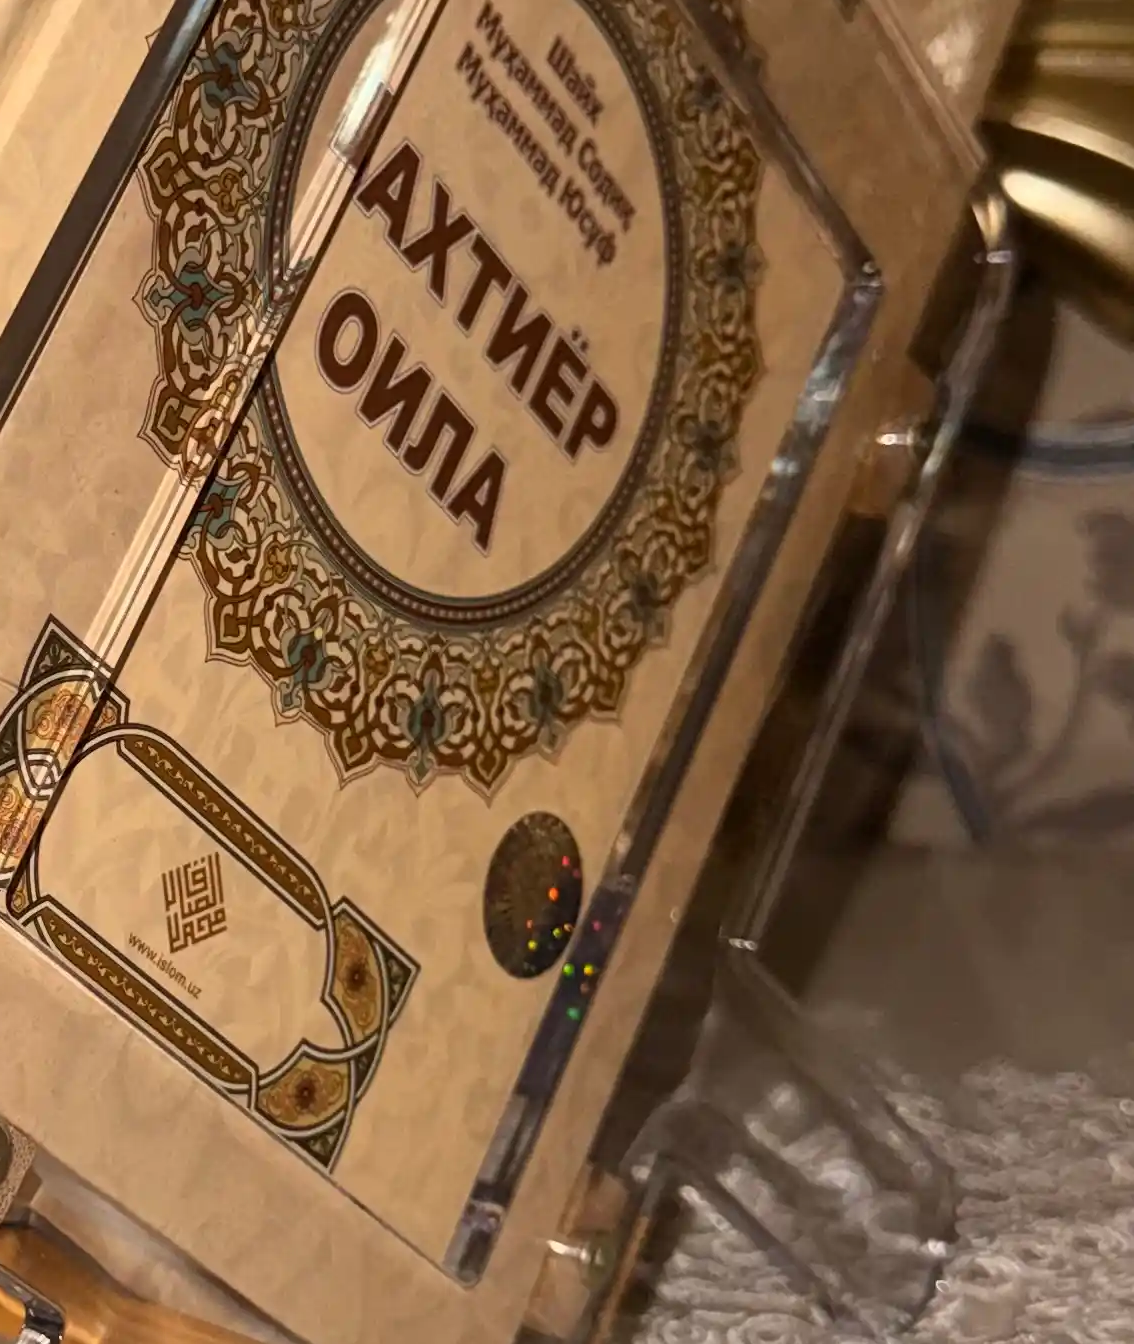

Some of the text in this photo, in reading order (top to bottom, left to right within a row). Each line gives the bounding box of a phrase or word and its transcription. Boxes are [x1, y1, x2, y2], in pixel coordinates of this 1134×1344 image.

[546, 32, 604, 128] Шайх
[558, 176, 617, 266] Юсуф
[332, 84, 621, 463] АХТИЁР
[316, 287, 508, 556] ОИЛА
[128, 932, 202, 1000] www.islom.uz
